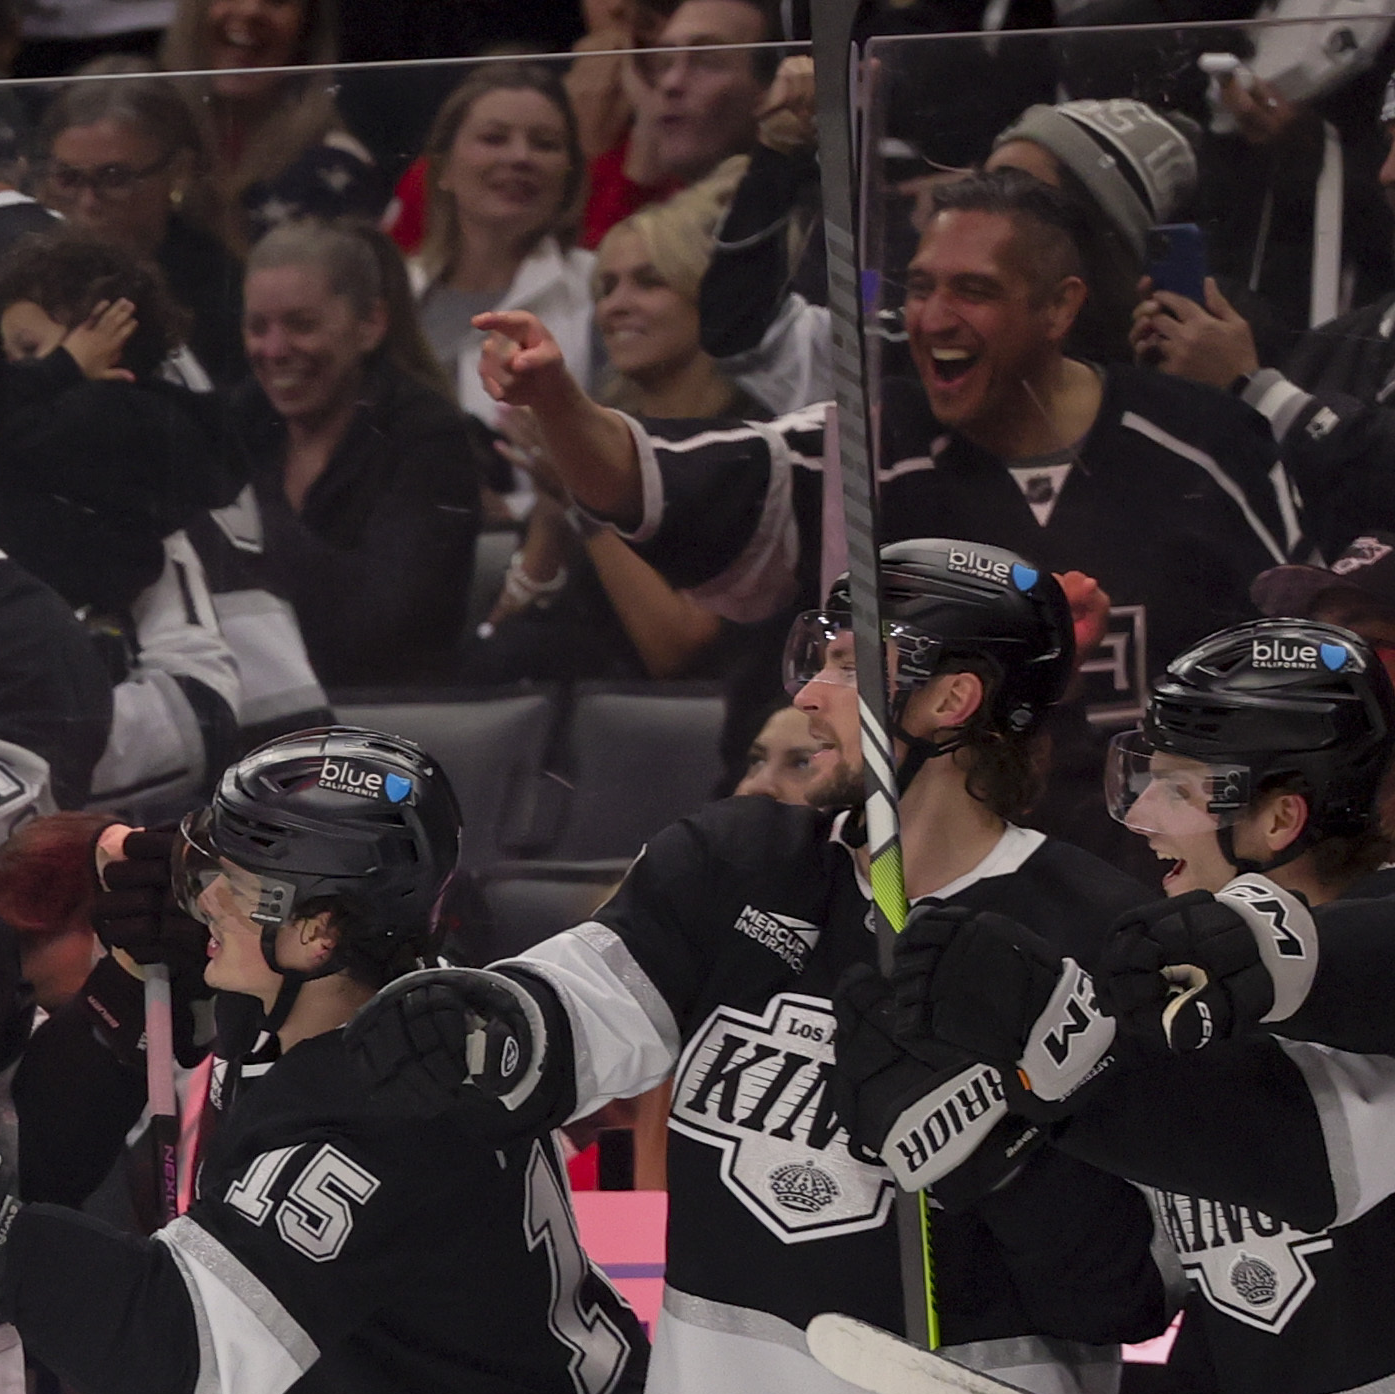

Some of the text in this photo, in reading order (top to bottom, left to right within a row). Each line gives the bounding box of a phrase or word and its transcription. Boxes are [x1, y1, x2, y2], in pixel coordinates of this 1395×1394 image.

[948, 547, 1010, 578] blue
[948, 563, 1009, 585] CALIFORNIA
[1251, 661, 1317, 669] CALIFORNIA
[1252, 639, 1318, 662] blue
[318, 779, 379, 798] CALIFORNIA
[320, 758, 383, 790] blue
[739, 903, 806, 956] MERCUR
[684, 1032, 888, 1167] KIN
[895, 1069, 1006, 1174] RRIOR
[163, 1144, 178, 1220] NEXU
[223, 1142, 381, 1263] 15
